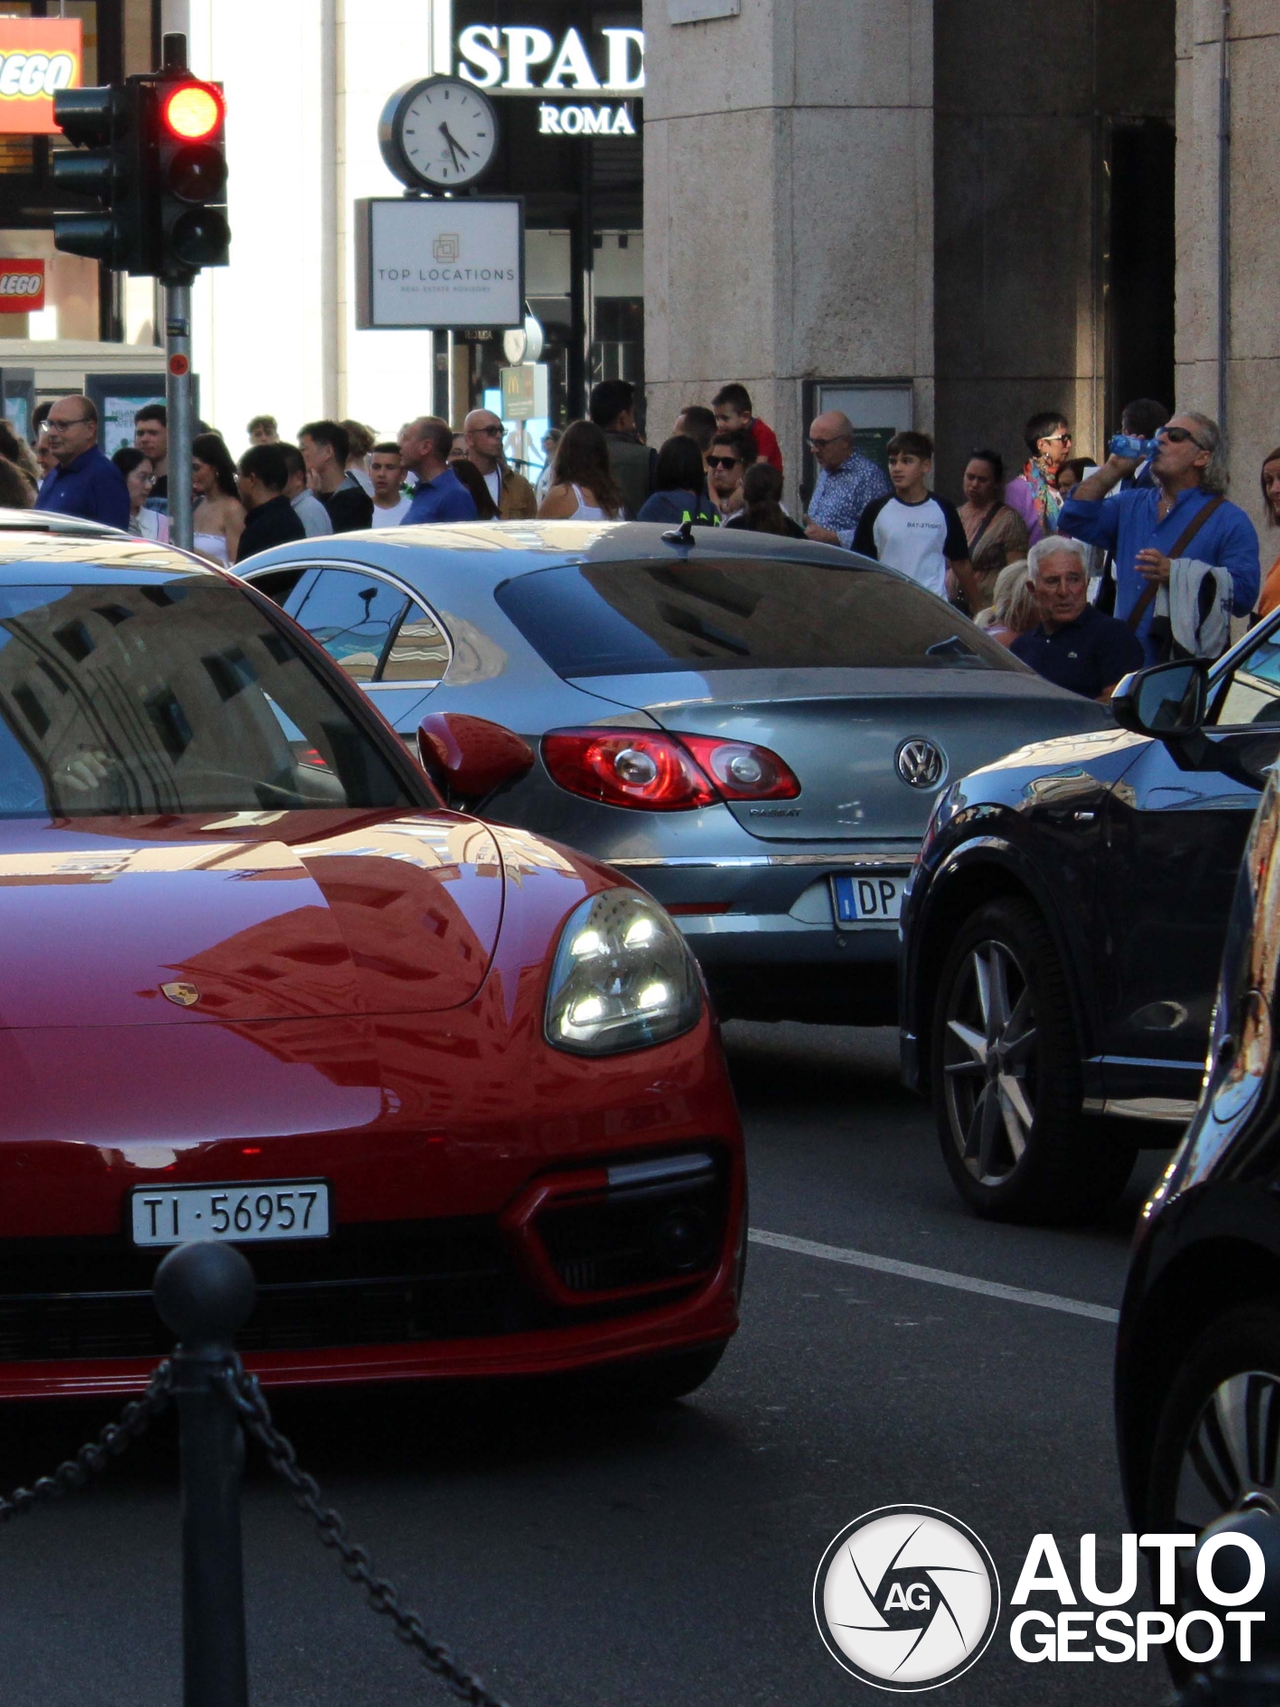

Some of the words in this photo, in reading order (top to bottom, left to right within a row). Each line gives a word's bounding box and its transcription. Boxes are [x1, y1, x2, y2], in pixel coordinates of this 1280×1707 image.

[458, 25, 645, 89] SPAD
[539, 105, 635, 134] ROMA
[378, 269, 411, 281] TOP
[419, 269, 515, 281] LOCATIONS
[749, 807, 802, 818] PASSAT
[857, 880, 896, 915] DP
